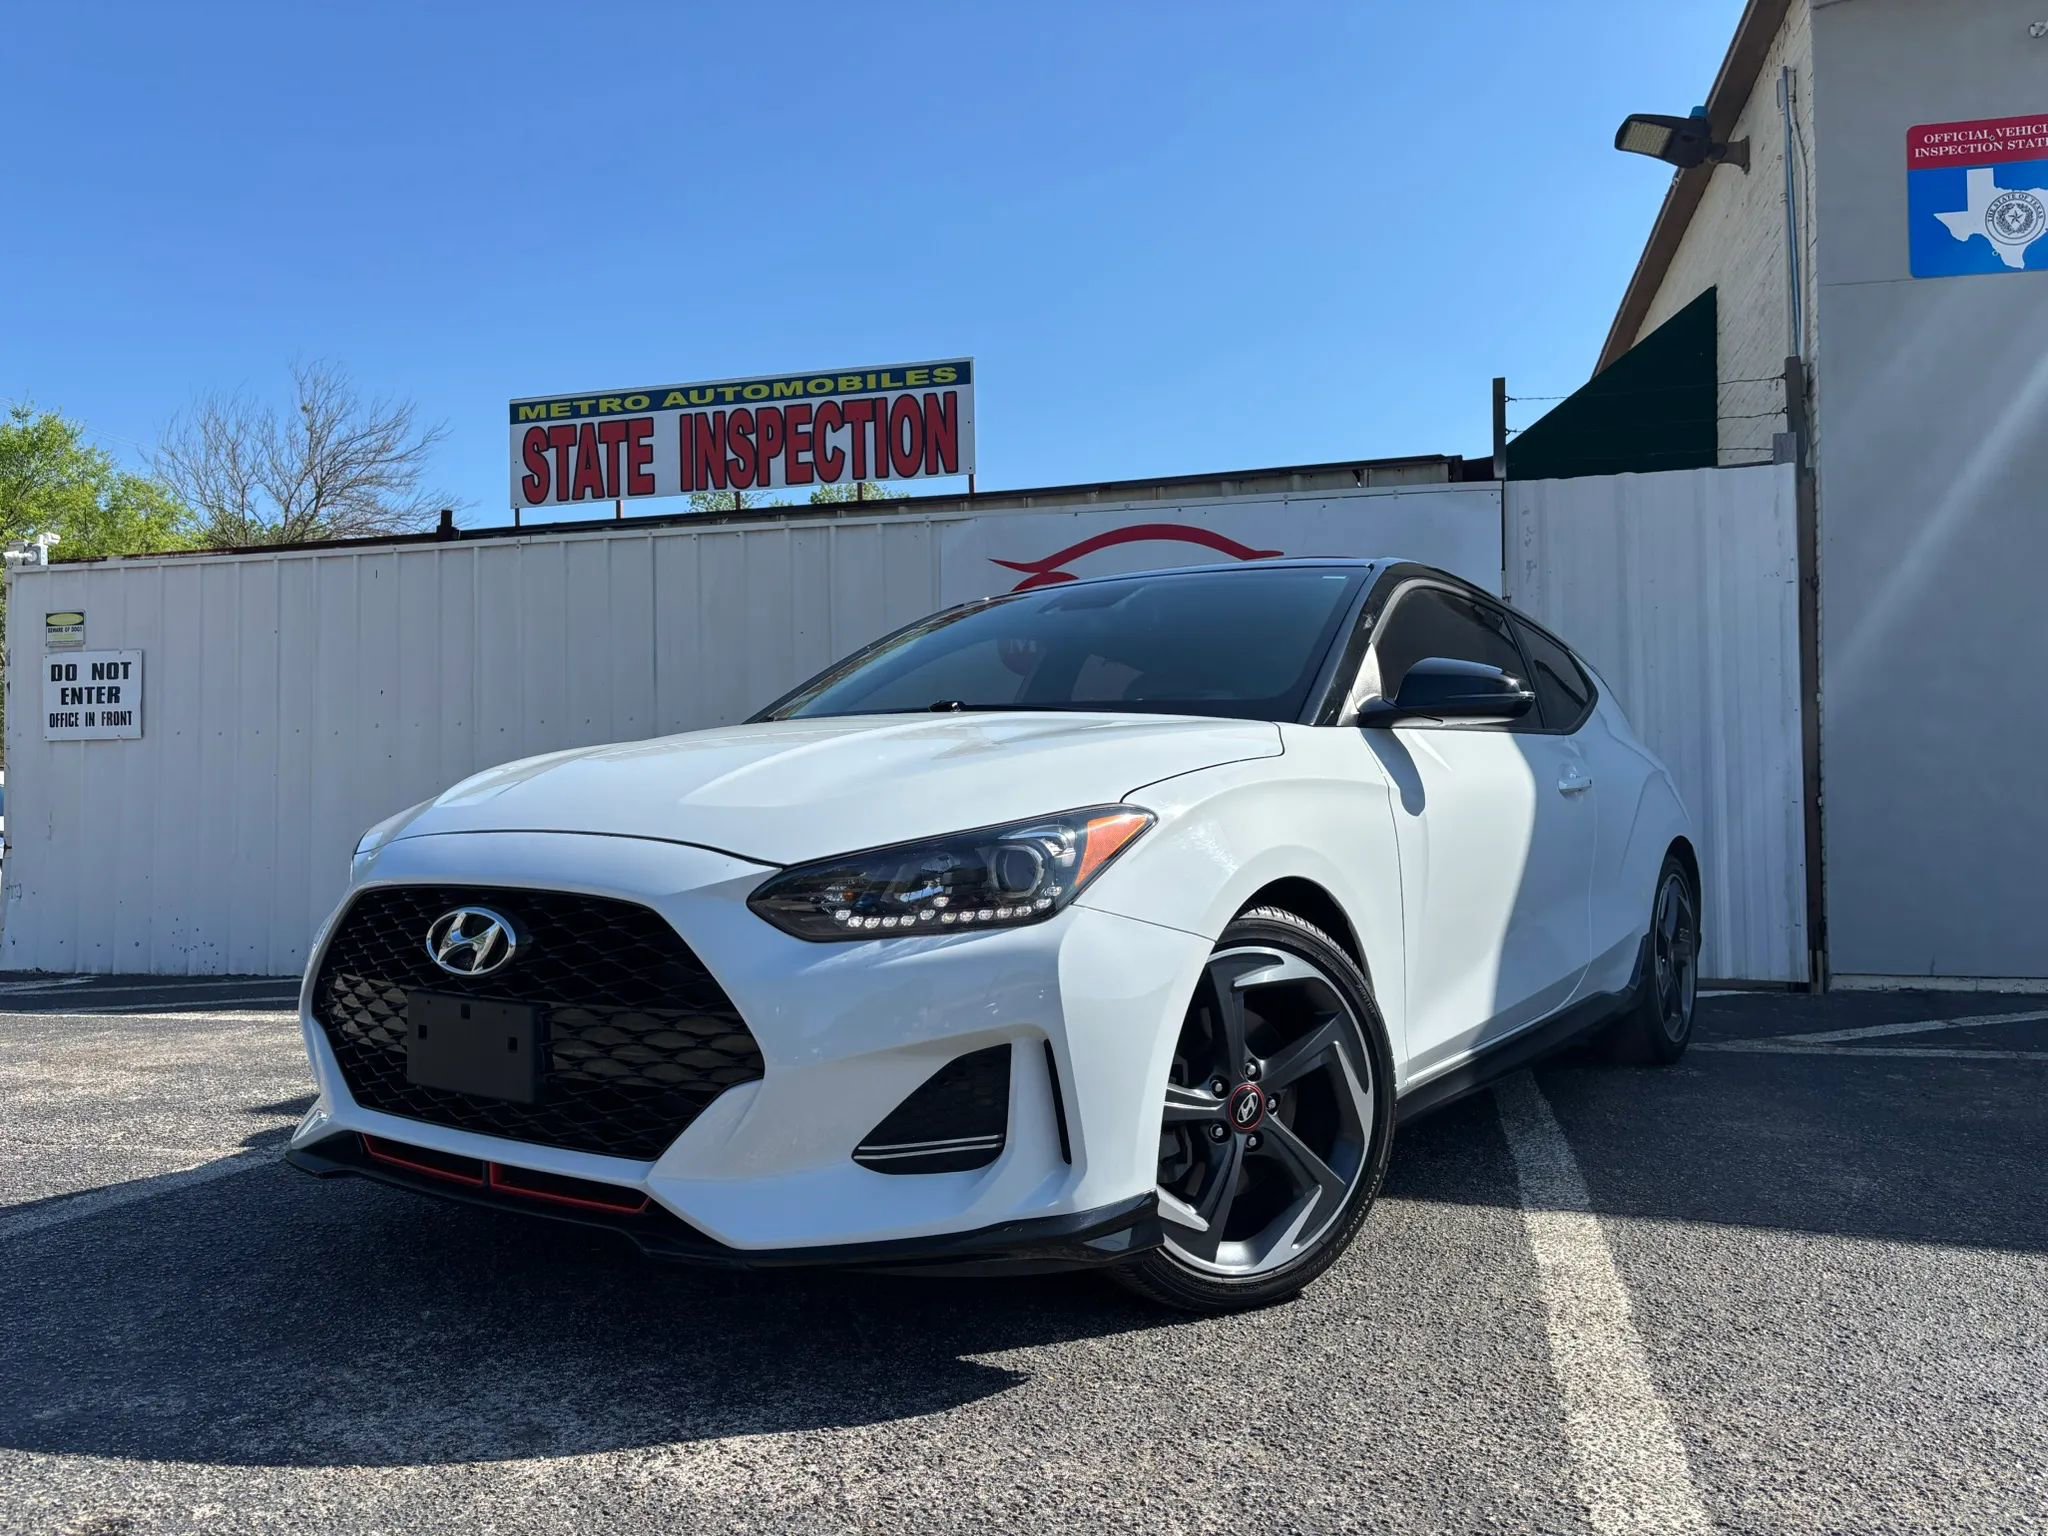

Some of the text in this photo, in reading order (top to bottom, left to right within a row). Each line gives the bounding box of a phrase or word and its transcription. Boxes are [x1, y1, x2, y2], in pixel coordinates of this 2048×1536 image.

[1924, 129, 1989, 144] OFFICIAL
[1914, 141, 2003, 158] INSPECTION
[1993, 193, 2015, 207] STATE
[2029, 198, 2044, 219] TEXAS
[518, 366, 958, 421] METRO AUTOMOBILES
[521, 390, 959, 505] STATE INSPECTION
[50, 661, 132, 682] DO NOT
[60, 685, 121, 706] ENTER
[49, 710, 133, 728] OFFICE IN FRONT
